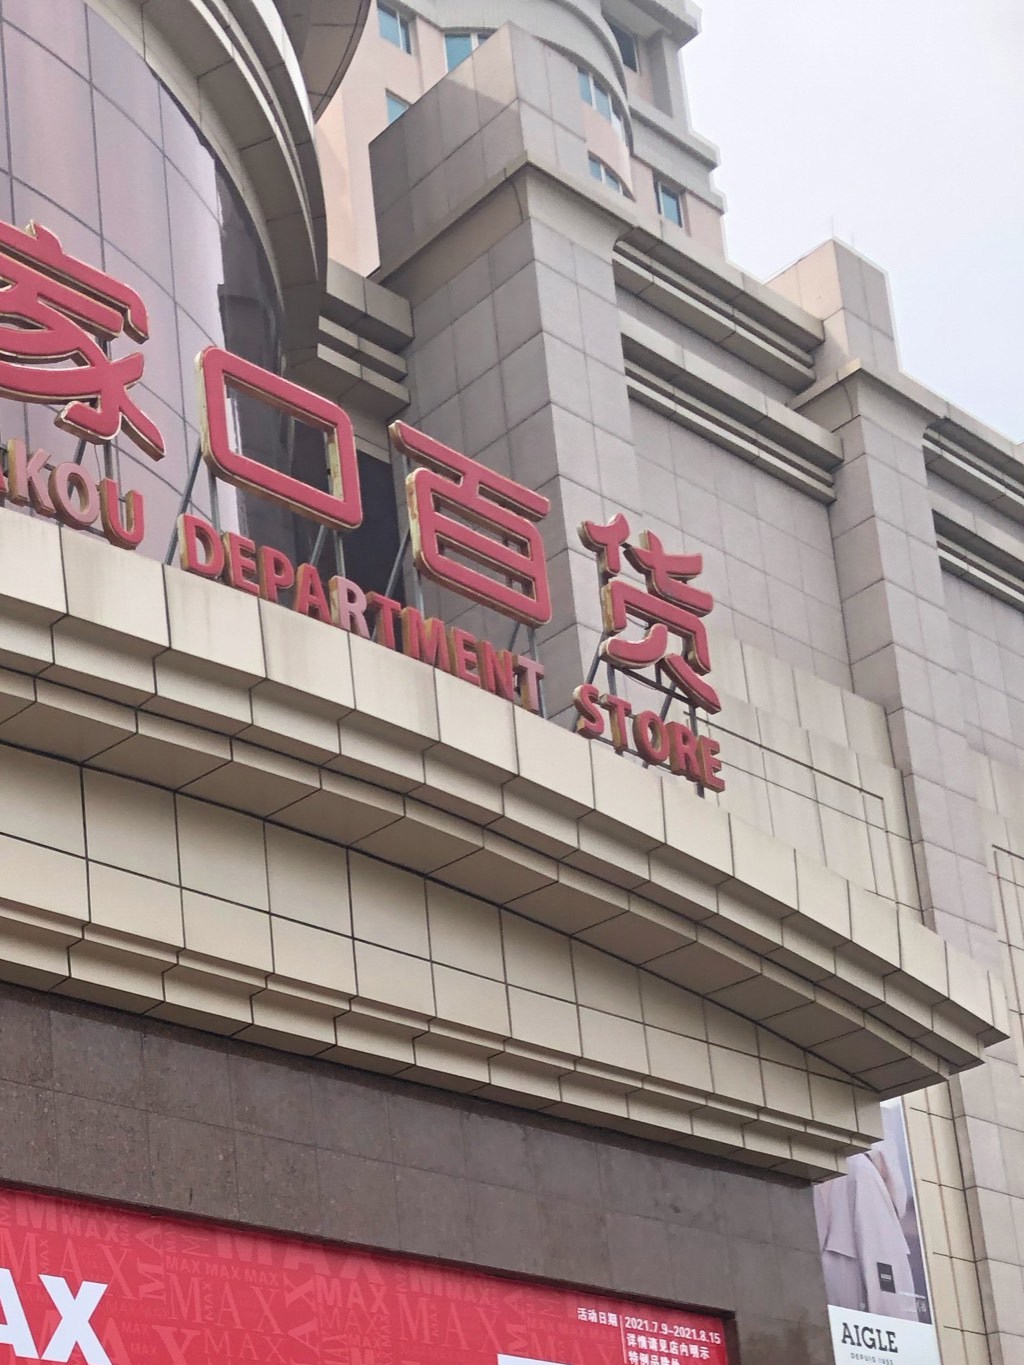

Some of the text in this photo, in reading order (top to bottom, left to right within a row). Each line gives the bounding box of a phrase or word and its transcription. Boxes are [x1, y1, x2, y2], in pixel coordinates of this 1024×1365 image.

[178, 513, 544, 713] DEPARTMENT
[573, 683, 726, 793] STORE
[166, 1255, 279, 1287] MAX MAX MAX
[314, 1274, 390, 1315] MAX
[577, 1307, 619, 1327] 活动日期
[204, 1327, 287, 1364] MAX
[841, 1322, 898, 1353] AIGLE
